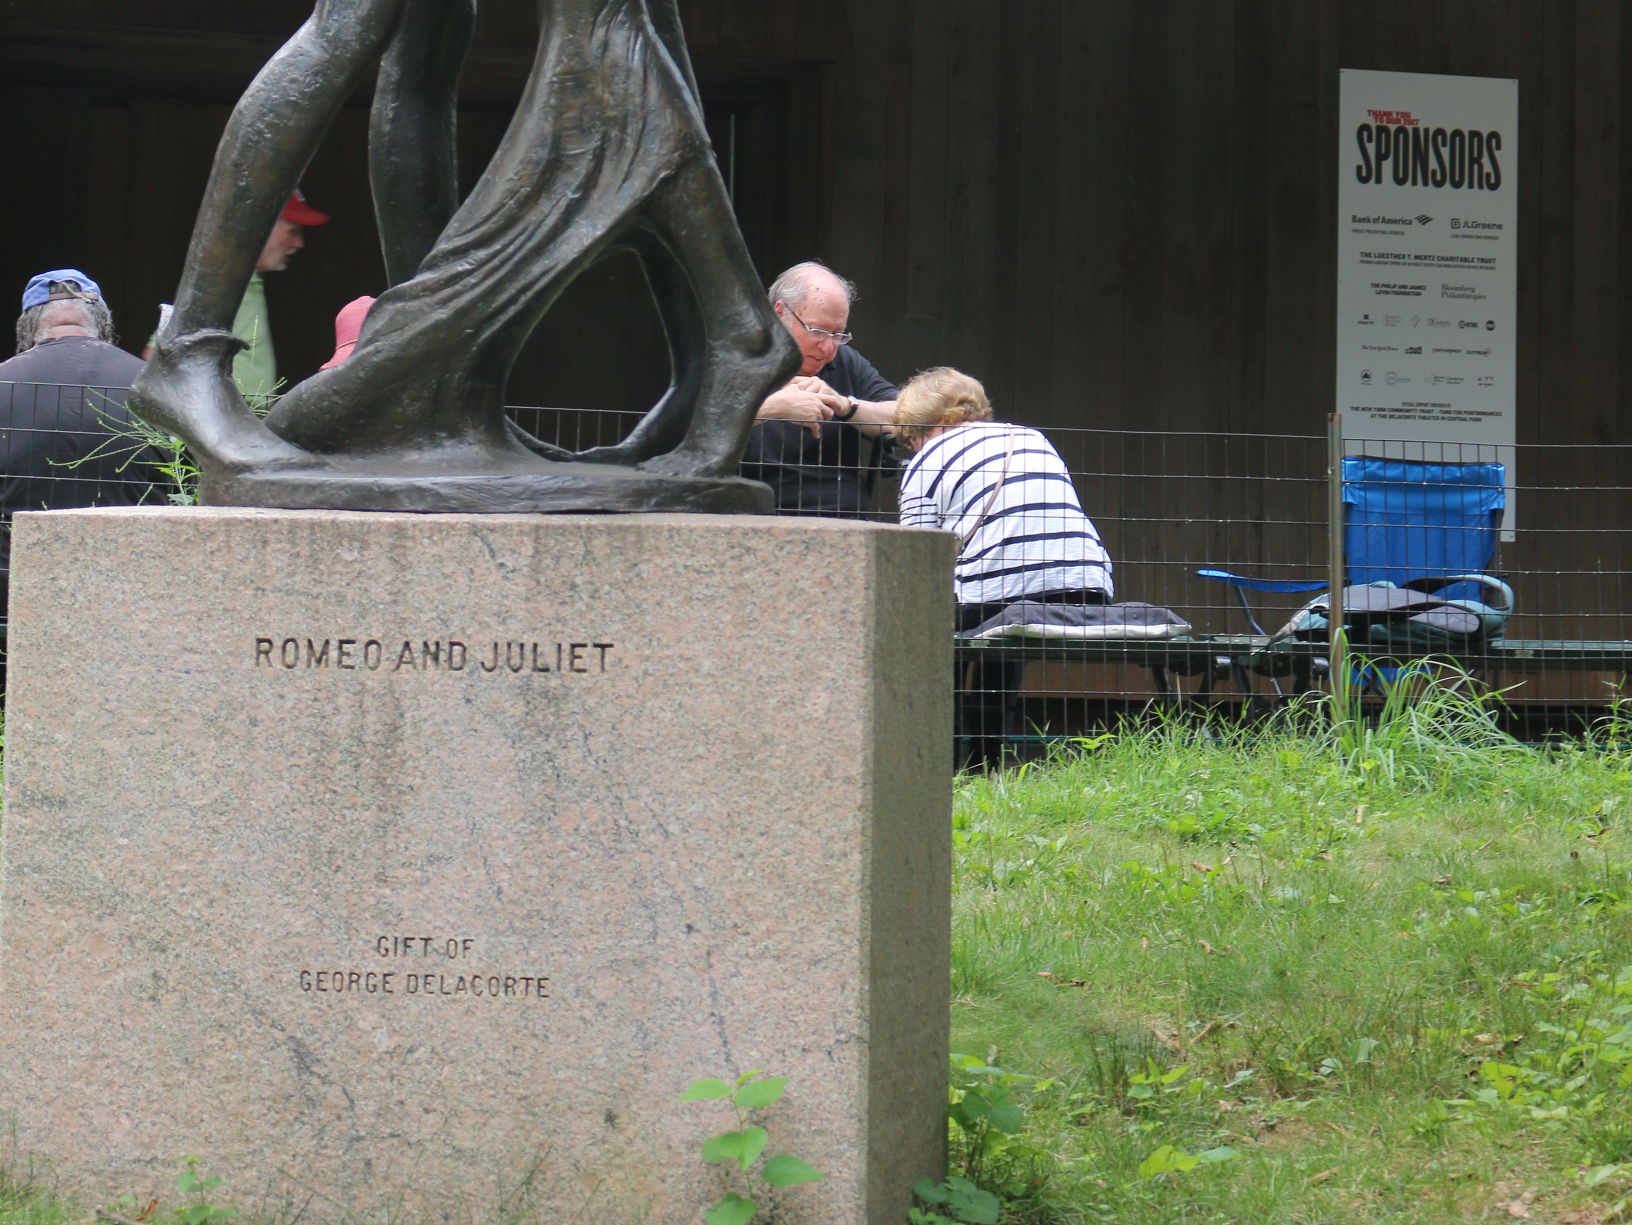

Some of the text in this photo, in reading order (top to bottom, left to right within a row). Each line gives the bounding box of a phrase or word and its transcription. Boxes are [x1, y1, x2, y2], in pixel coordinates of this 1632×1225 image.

[1367, 110, 1411, 119] THANK YOU
[1356, 123, 1502, 191] SPONSORS
[1351, 214, 1413, 226] Bank of America
[1436, 255, 1475, 263] CHARITABLE
[255, 637, 615, 674] ROMEO AND JULIET
[377, 935, 475, 960] GIFT OF
[299, 970, 551, 998] GEORGE DELACORTE
